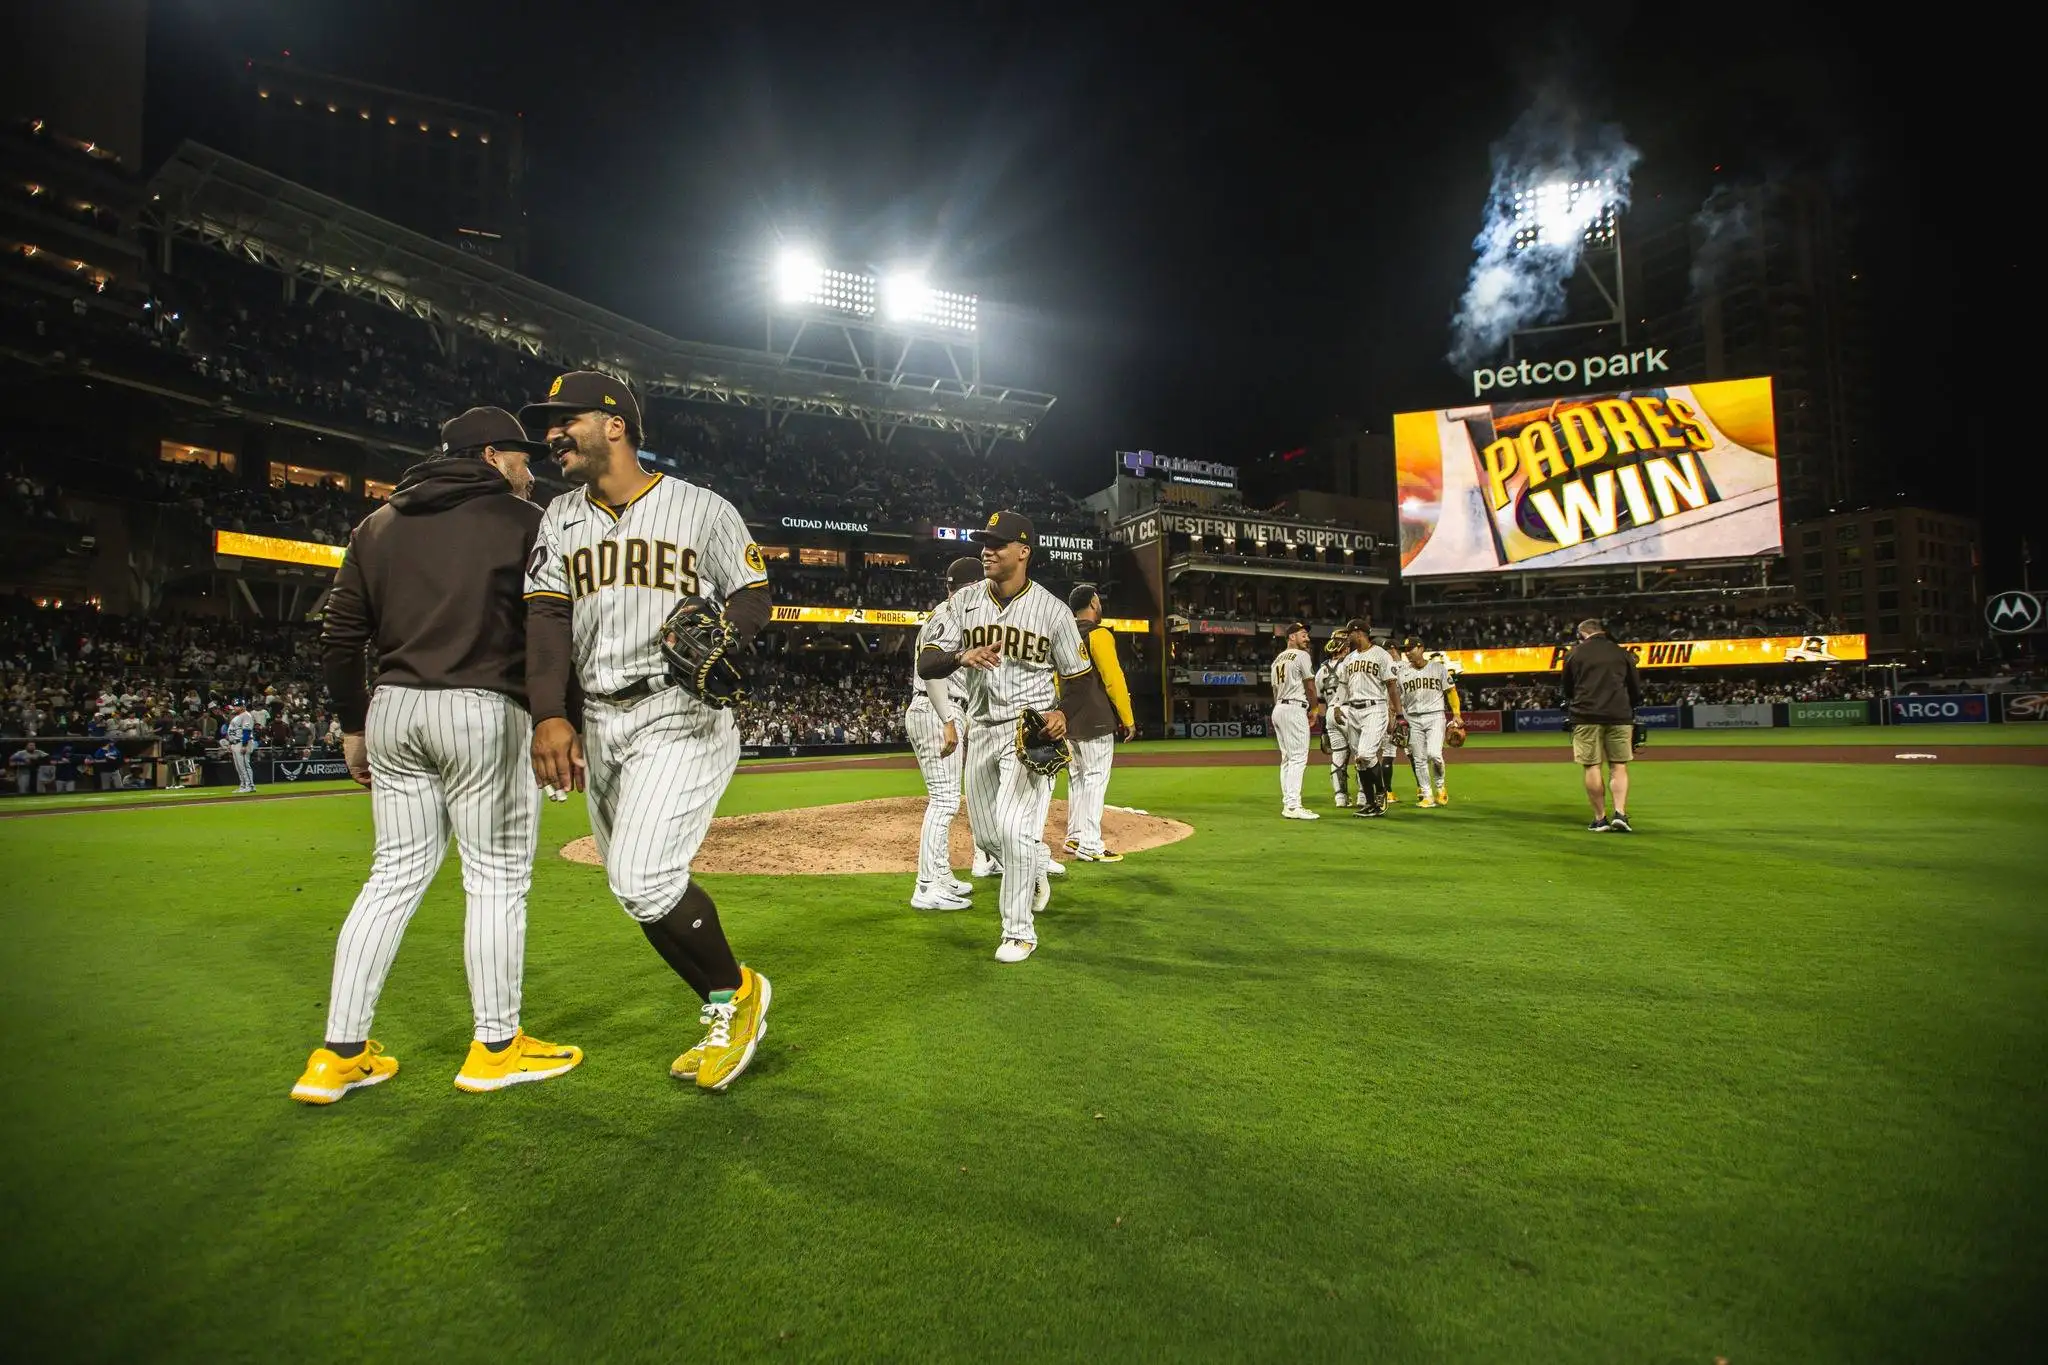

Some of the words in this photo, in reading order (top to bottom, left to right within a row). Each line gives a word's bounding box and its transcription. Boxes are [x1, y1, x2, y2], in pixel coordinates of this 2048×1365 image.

[1473, 358, 1577, 397] petco
[1583, 347, 1669, 386] park
[1483, 397, 1714, 510] PADRES
[1529, 452, 1709, 548] WIN
[781, 517, 822, 529] CIUDAD
[824, 520, 868, 532] MADERAS
[1161, 515, 1236, 538] WESTERN
[1243, 523, 1293, 544] METAL
[1296, 528, 1349, 549] SUPPLY
[1038, 534, 1094, 550] CUTWATER
[1050, 550, 1083, 561] SPIRITS
[776, 607, 800, 620] WIN
[876, 611, 906, 623] PADRES
[1647, 642, 1694, 665] WIN
[1403, 676, 1442, 695] PADRES
[1895, 702, 1960, 718] ARCO
[1193, 723, 1240, 738] ORIS
[1245, 724, 1263, 736] 342
[305, 763, 325, 775] AIR
